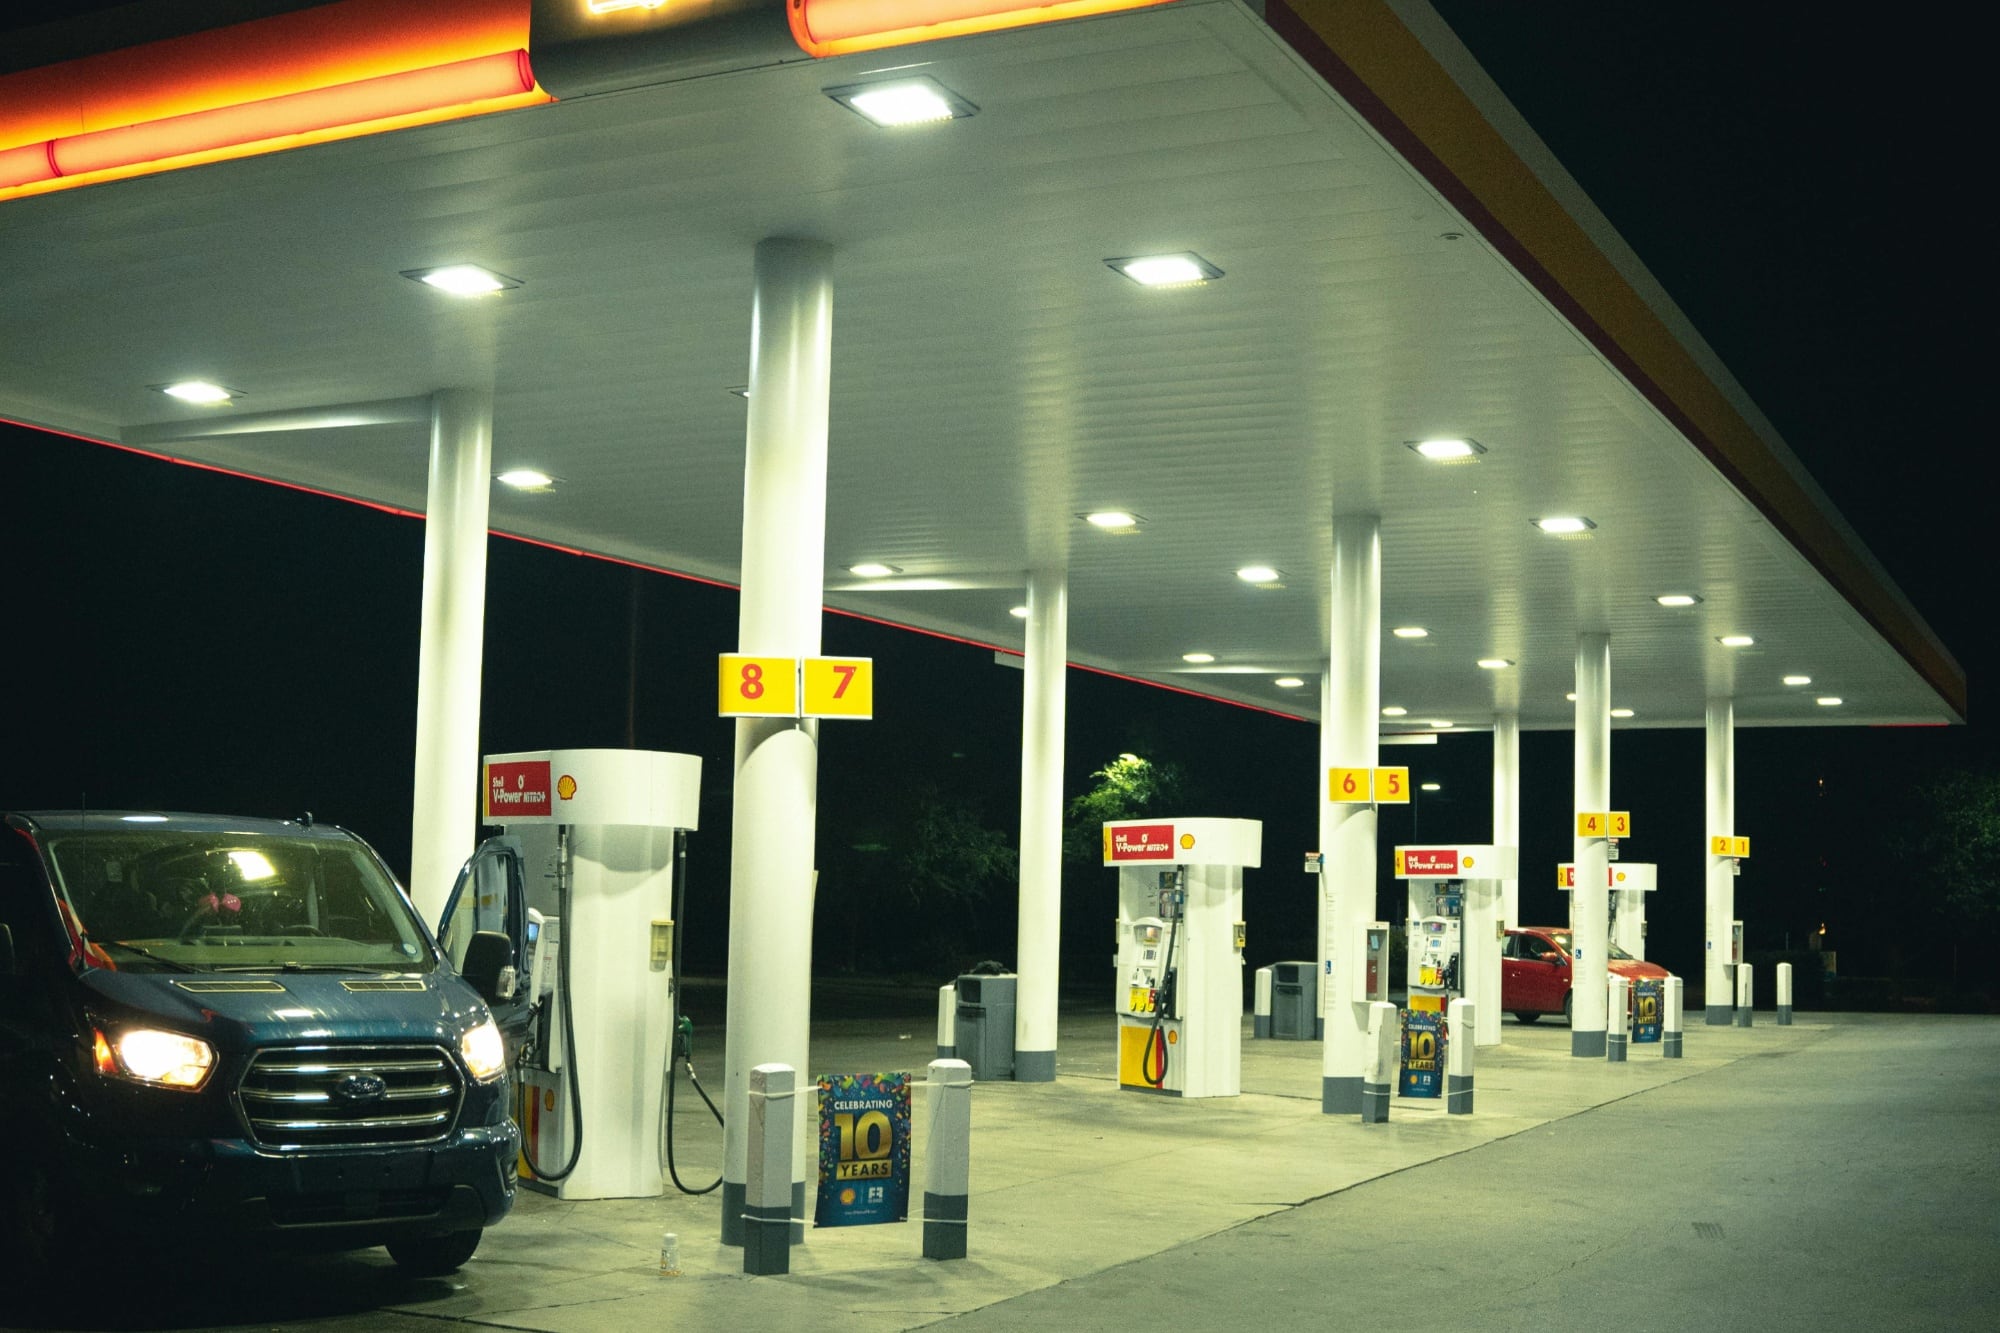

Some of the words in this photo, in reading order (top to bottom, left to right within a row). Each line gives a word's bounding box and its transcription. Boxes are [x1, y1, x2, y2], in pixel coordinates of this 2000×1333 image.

[740, 663, 764, 699] 8
[833, 666, 857, 699] 7
[492, 776, 504, 788] Shell
[1343, 773, 1356, 794] 6
[1388, 774, 1400, 794] 5
[493, 788, 522, 803] V-Power
[1587, 816, 1597, 831] 4
[1616, 816, 1625, 832] 3
[1115, 843, 1146, 852] V-Power
[1720, 839, 1726, 851] 2
[1741, 841, 1745, 853] 1
[1637, 996, 1656, 1017] 10
[1408, 1031, 1435, 1059] 10
[1410, 1061, 1434, 1070] YEARS
[834, 1100, 893, 1110] CELEBRATING
[834, 1110, 893, 1160] 10
[841, 1163, 888, 1177] YEARS
